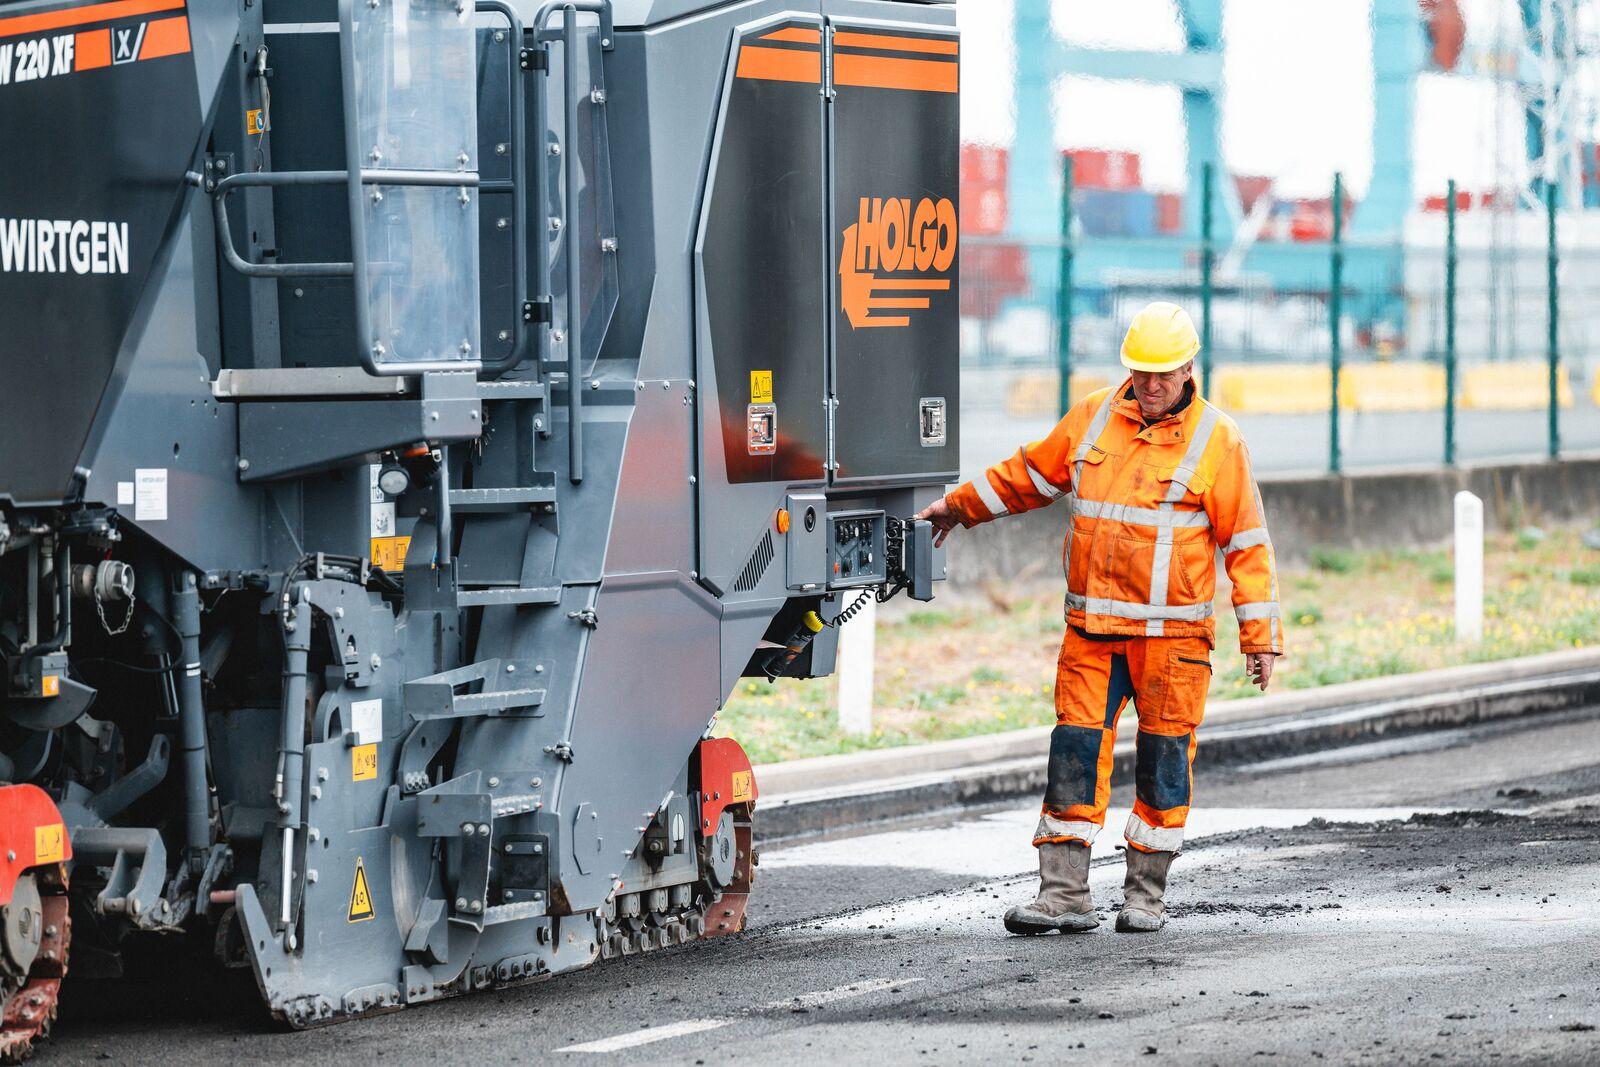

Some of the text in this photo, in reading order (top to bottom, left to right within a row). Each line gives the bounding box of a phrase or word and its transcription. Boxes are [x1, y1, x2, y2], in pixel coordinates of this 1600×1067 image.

[15, 38, 50, 83] 220
[51, 34, 75, 76] XF
[117, 29, 131, 58] X
[0, 218, 129, 274] WIRTGEN
[856, 197, 957, 272] HOLGO
